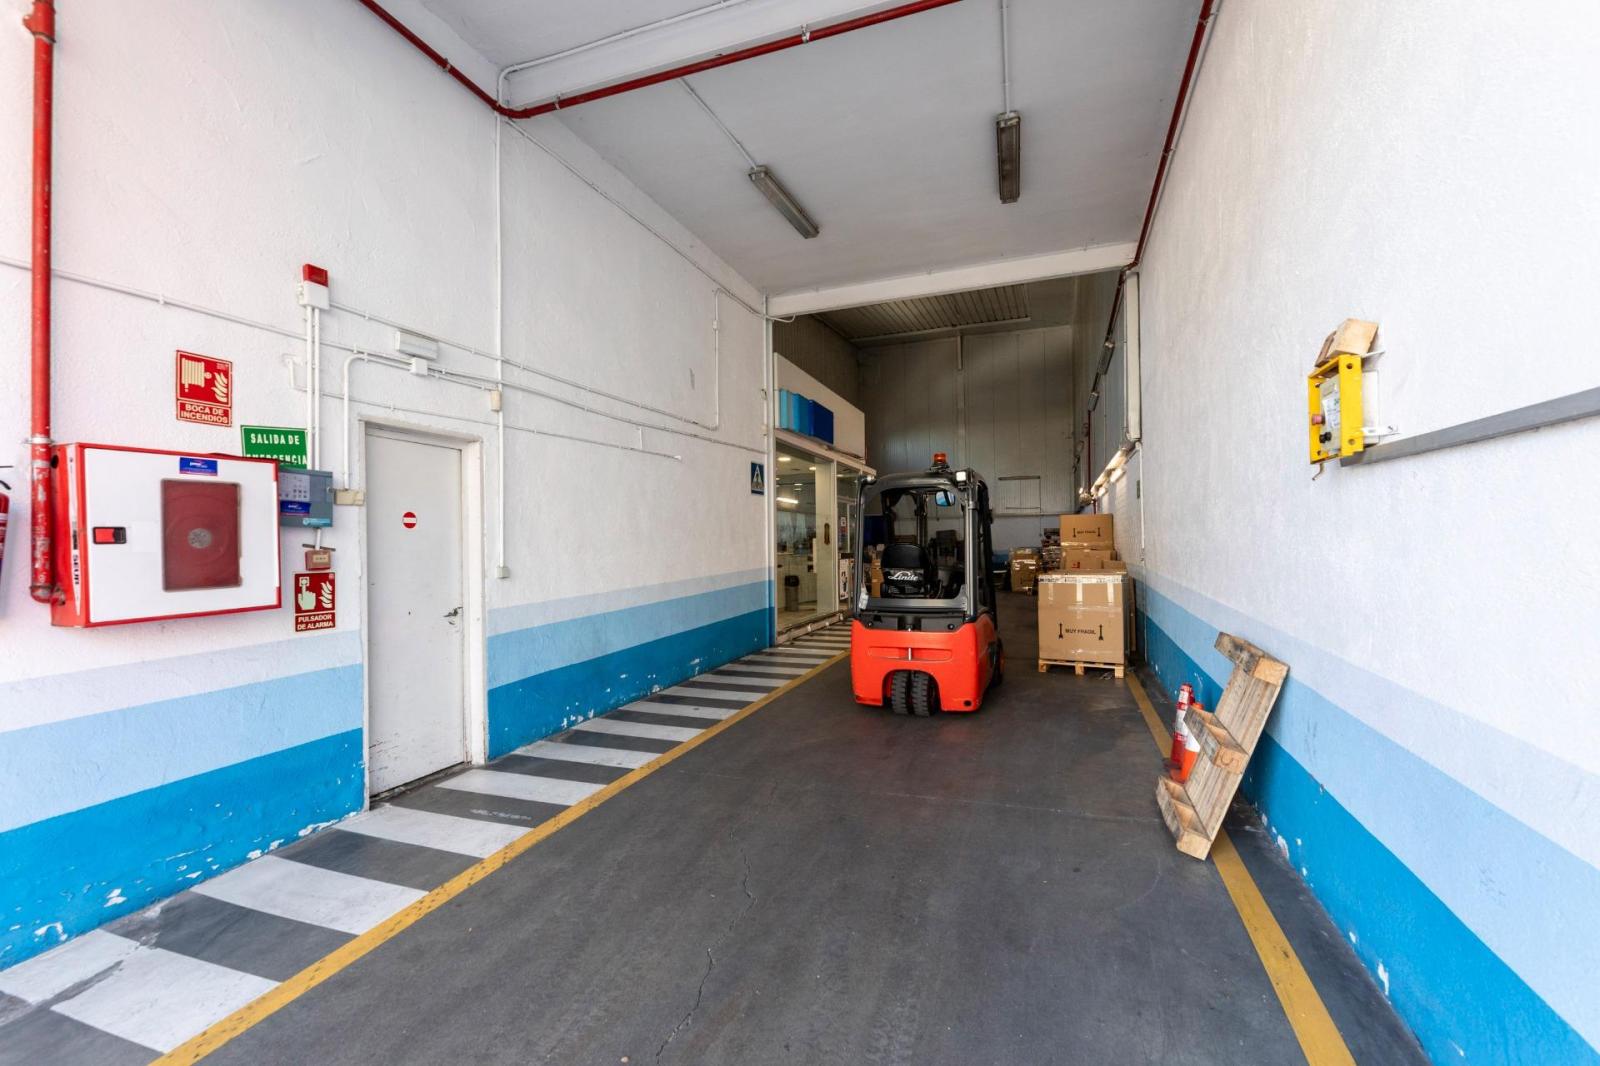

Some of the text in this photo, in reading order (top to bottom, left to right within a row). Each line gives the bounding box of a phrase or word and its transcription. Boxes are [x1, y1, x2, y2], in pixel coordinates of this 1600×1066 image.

[185, 403, 225, 416] BOCA DE
[180, 410, 228, 424] INCENDIOS
[250, 433, 300, 445] SALIDA DE
[887, 570, 919, 581] Linde
[298, 613, 333, 623] PULSADOR
[297, 620, 334, 631] DE ALARMA
